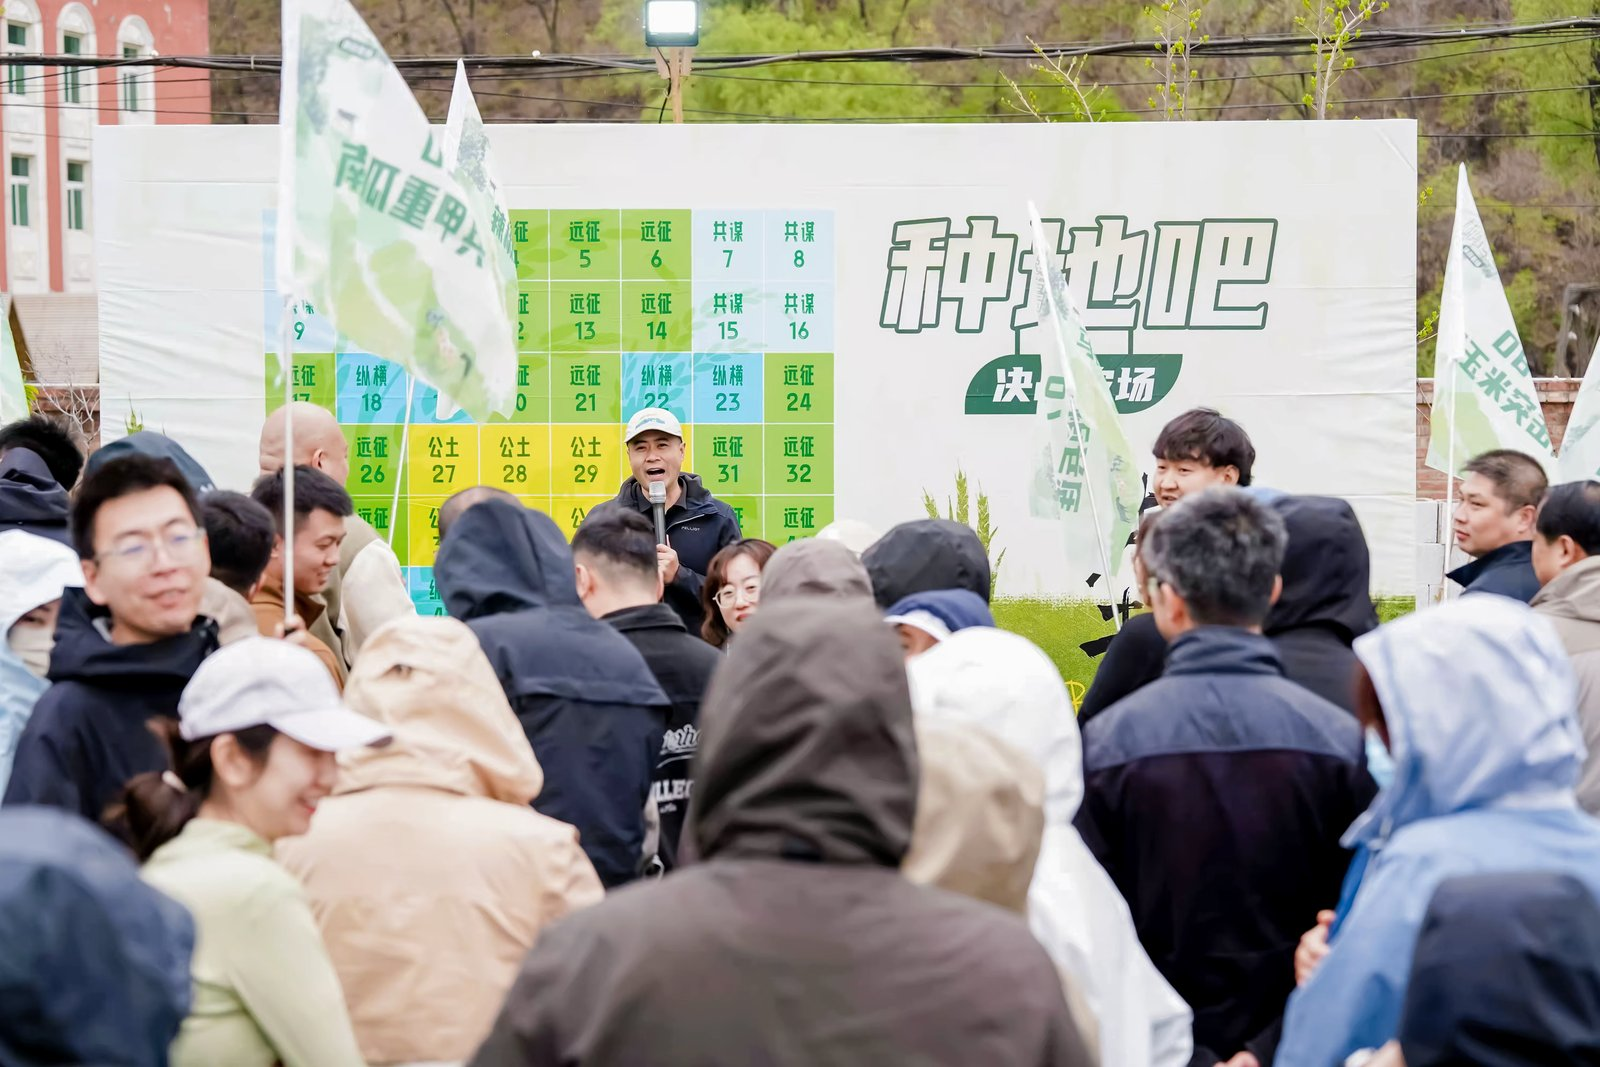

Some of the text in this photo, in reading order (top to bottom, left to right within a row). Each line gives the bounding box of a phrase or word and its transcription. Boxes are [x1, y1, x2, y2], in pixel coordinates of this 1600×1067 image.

[570, 221, 601, 243] 远征
[642, 221, 672, 243] 远征
[713, 221, 743, 242] 共谋
[785, 221, 815, 242] 共谋
[579, 249, 591, 268] 5
[650, 249, 663, 268] 6
[722, 249, 733, 268] 7
[793, 249, 805, 268] 8
[879, 215, 1279, 334] 种地吧
[570, 293, 601, 315] 远征
[642, 293, 672, 315] 远征
[713, 293, 743, 314] 共谋
[785, 293, 815, 314] 共谋
[294, 321, 305, 340] 9
[574, 321, 596, 340] 13
[646, 321, 668, 340] 14
[718, 321, 738, 340] 15
[789, 321, 809, 340] 16
[355, 364, 387, 387] 纵横
[571, 364, 601, 386] 远征
[641, 364, 673, 387] 纵横
[712, 364, 744, 387] 纵横
[784, 364, 815, 386] 远征
[992, 366, 1156, 402] 决场
[361, 392, 383, 412] 18
[575, 392, 596, 412] 21
[644, 392, 669, 411] 22
[715, 392, 741, 412] 23
[786, 392, 812, 412] 24
[356, 436, 388, 458] 远征
[427, 436, 459, 458] 公土
[499, 436, 531, 458] 公土
[570, 436, 602, 458] 公土
[712, 436, 744, 458] 远征
[784, 436, 815, 458] 远征
[360, 464, 385, 484] 26
[432, 464, 456, 484] 27
[502, 464, 528, 484] 28
[574, 464, 598, 484] 29
[718, 464, 738, 483] 31
[786, 464, 812, 483] 32
[358, 507, 388, 529] 远征
[784, 507, 815, 529] 远征
